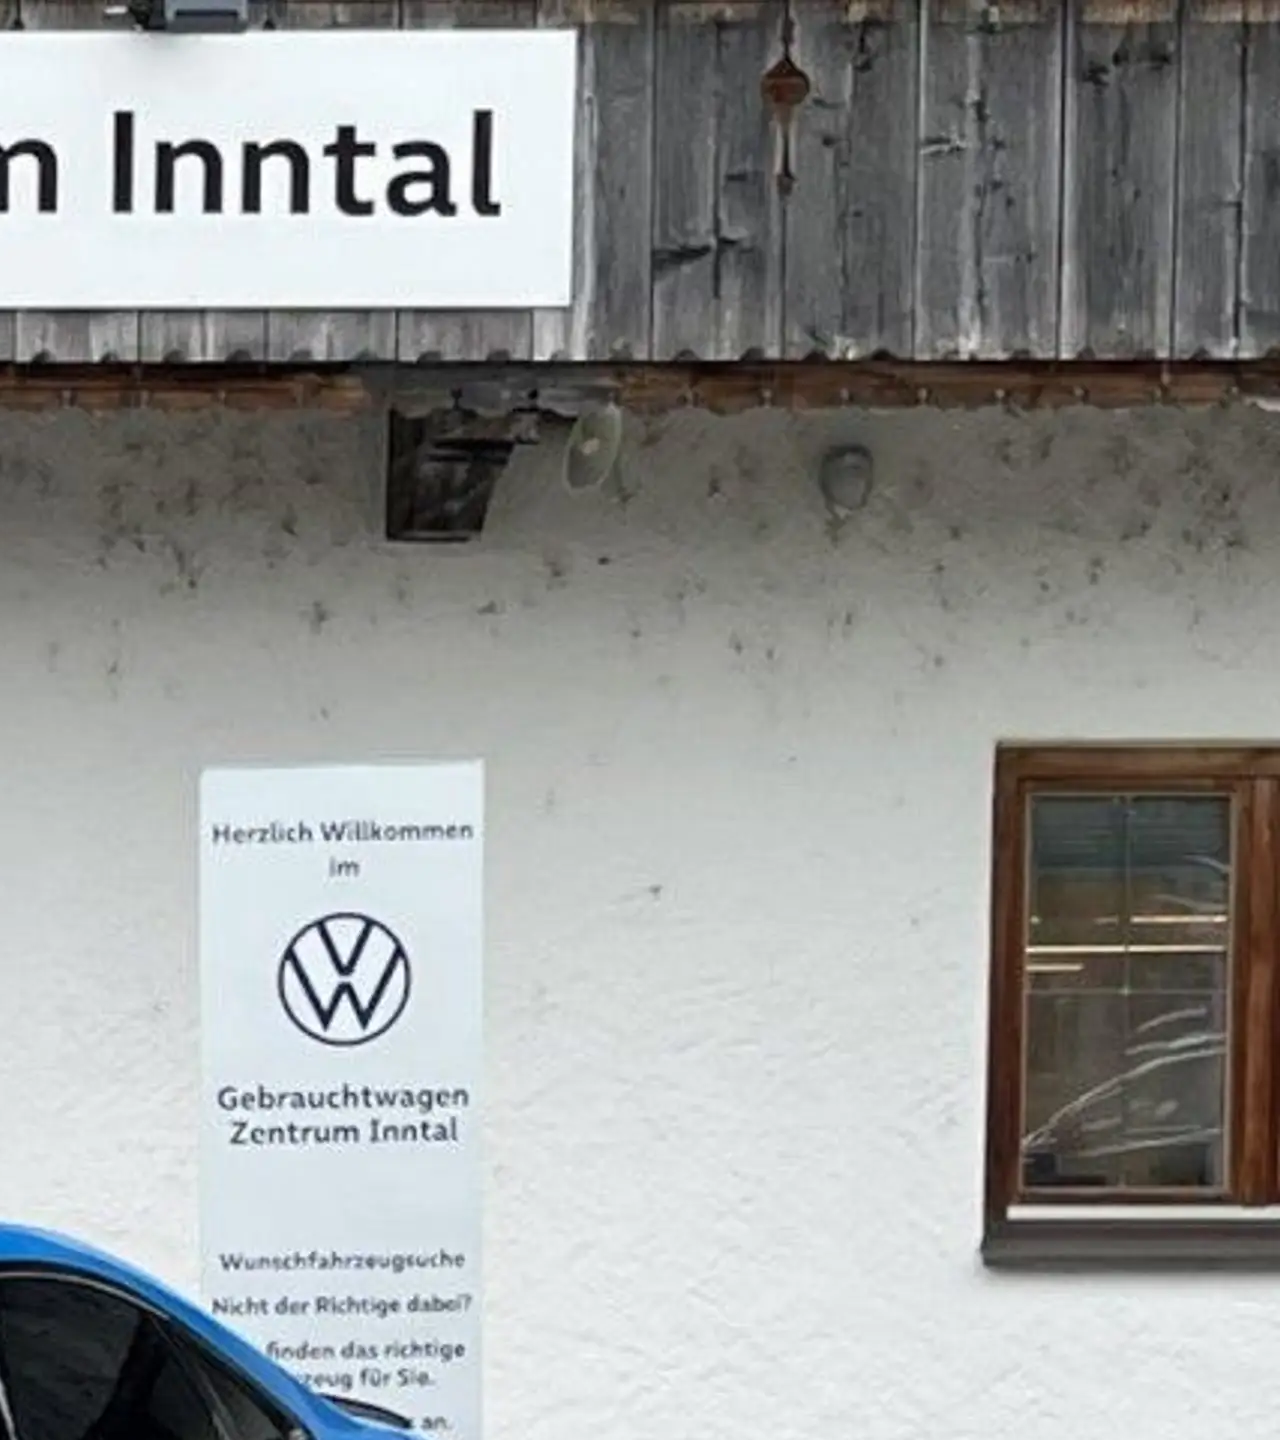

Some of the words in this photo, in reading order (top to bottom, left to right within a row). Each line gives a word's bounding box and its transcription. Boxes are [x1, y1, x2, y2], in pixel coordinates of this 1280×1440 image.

[112, 108, 502, 218] Inntal
[212, 820, 314, 845] Herzlich
[319, 820, 474, 842] Willkommen
[329, 858, 361, 877] im
[216, 1082, 470, 1113] Gebrauchtwagen
[229, 1120, 361, 1146] Zentrum
[369, 1117, 459, 1144] Inntal
[218, 1248, 467, 1274] Wunschfahrzeugsuche
[211, 1296, 269, 1319] Nicht
[273, 1295, 311, 1316] der
[314, 1295, 401, 1319] Richtige
[406, 1293, 473, 1314] dabei?
[339, 1340, 379, 1360] das
[383, 1340, 466, 1364] richtige
[359, 1367, 392, 1388] für
[396, 1367, 436, 1388] Sie.
